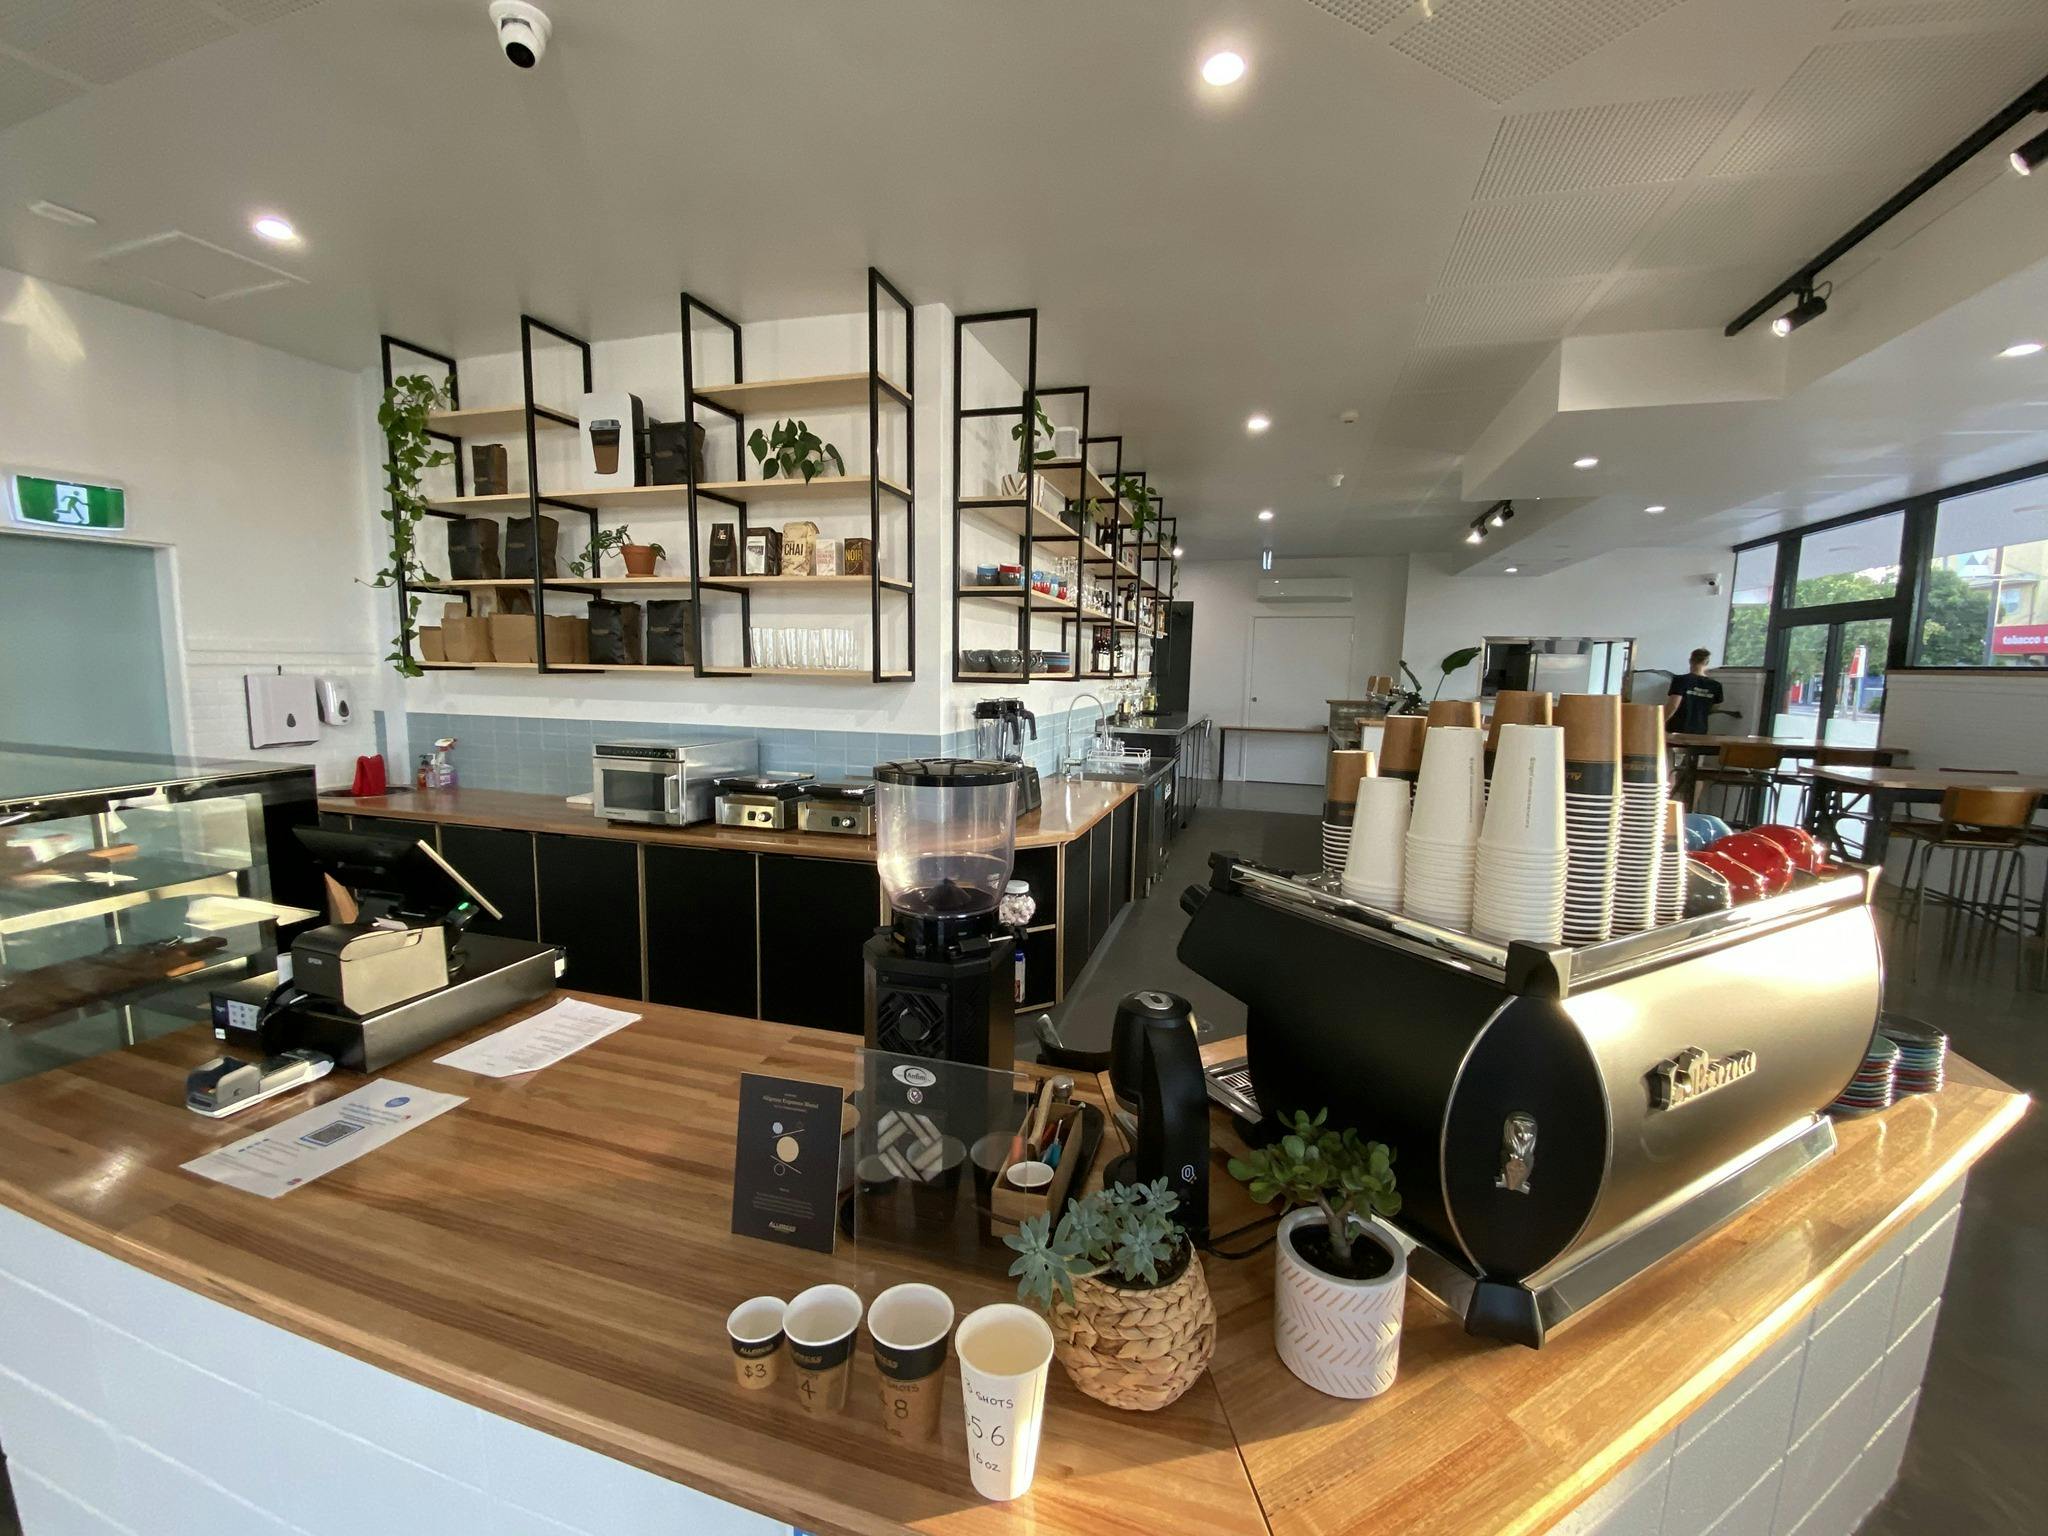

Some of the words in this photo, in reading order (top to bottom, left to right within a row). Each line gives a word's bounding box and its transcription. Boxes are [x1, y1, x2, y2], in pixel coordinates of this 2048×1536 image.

[784, 543, 804, 556] CHAI
[845, 549, 863, 562] NOIR
[744, 1363, 767, 1378] $3
[975, 1391, 1014, 1409] SHOTS
